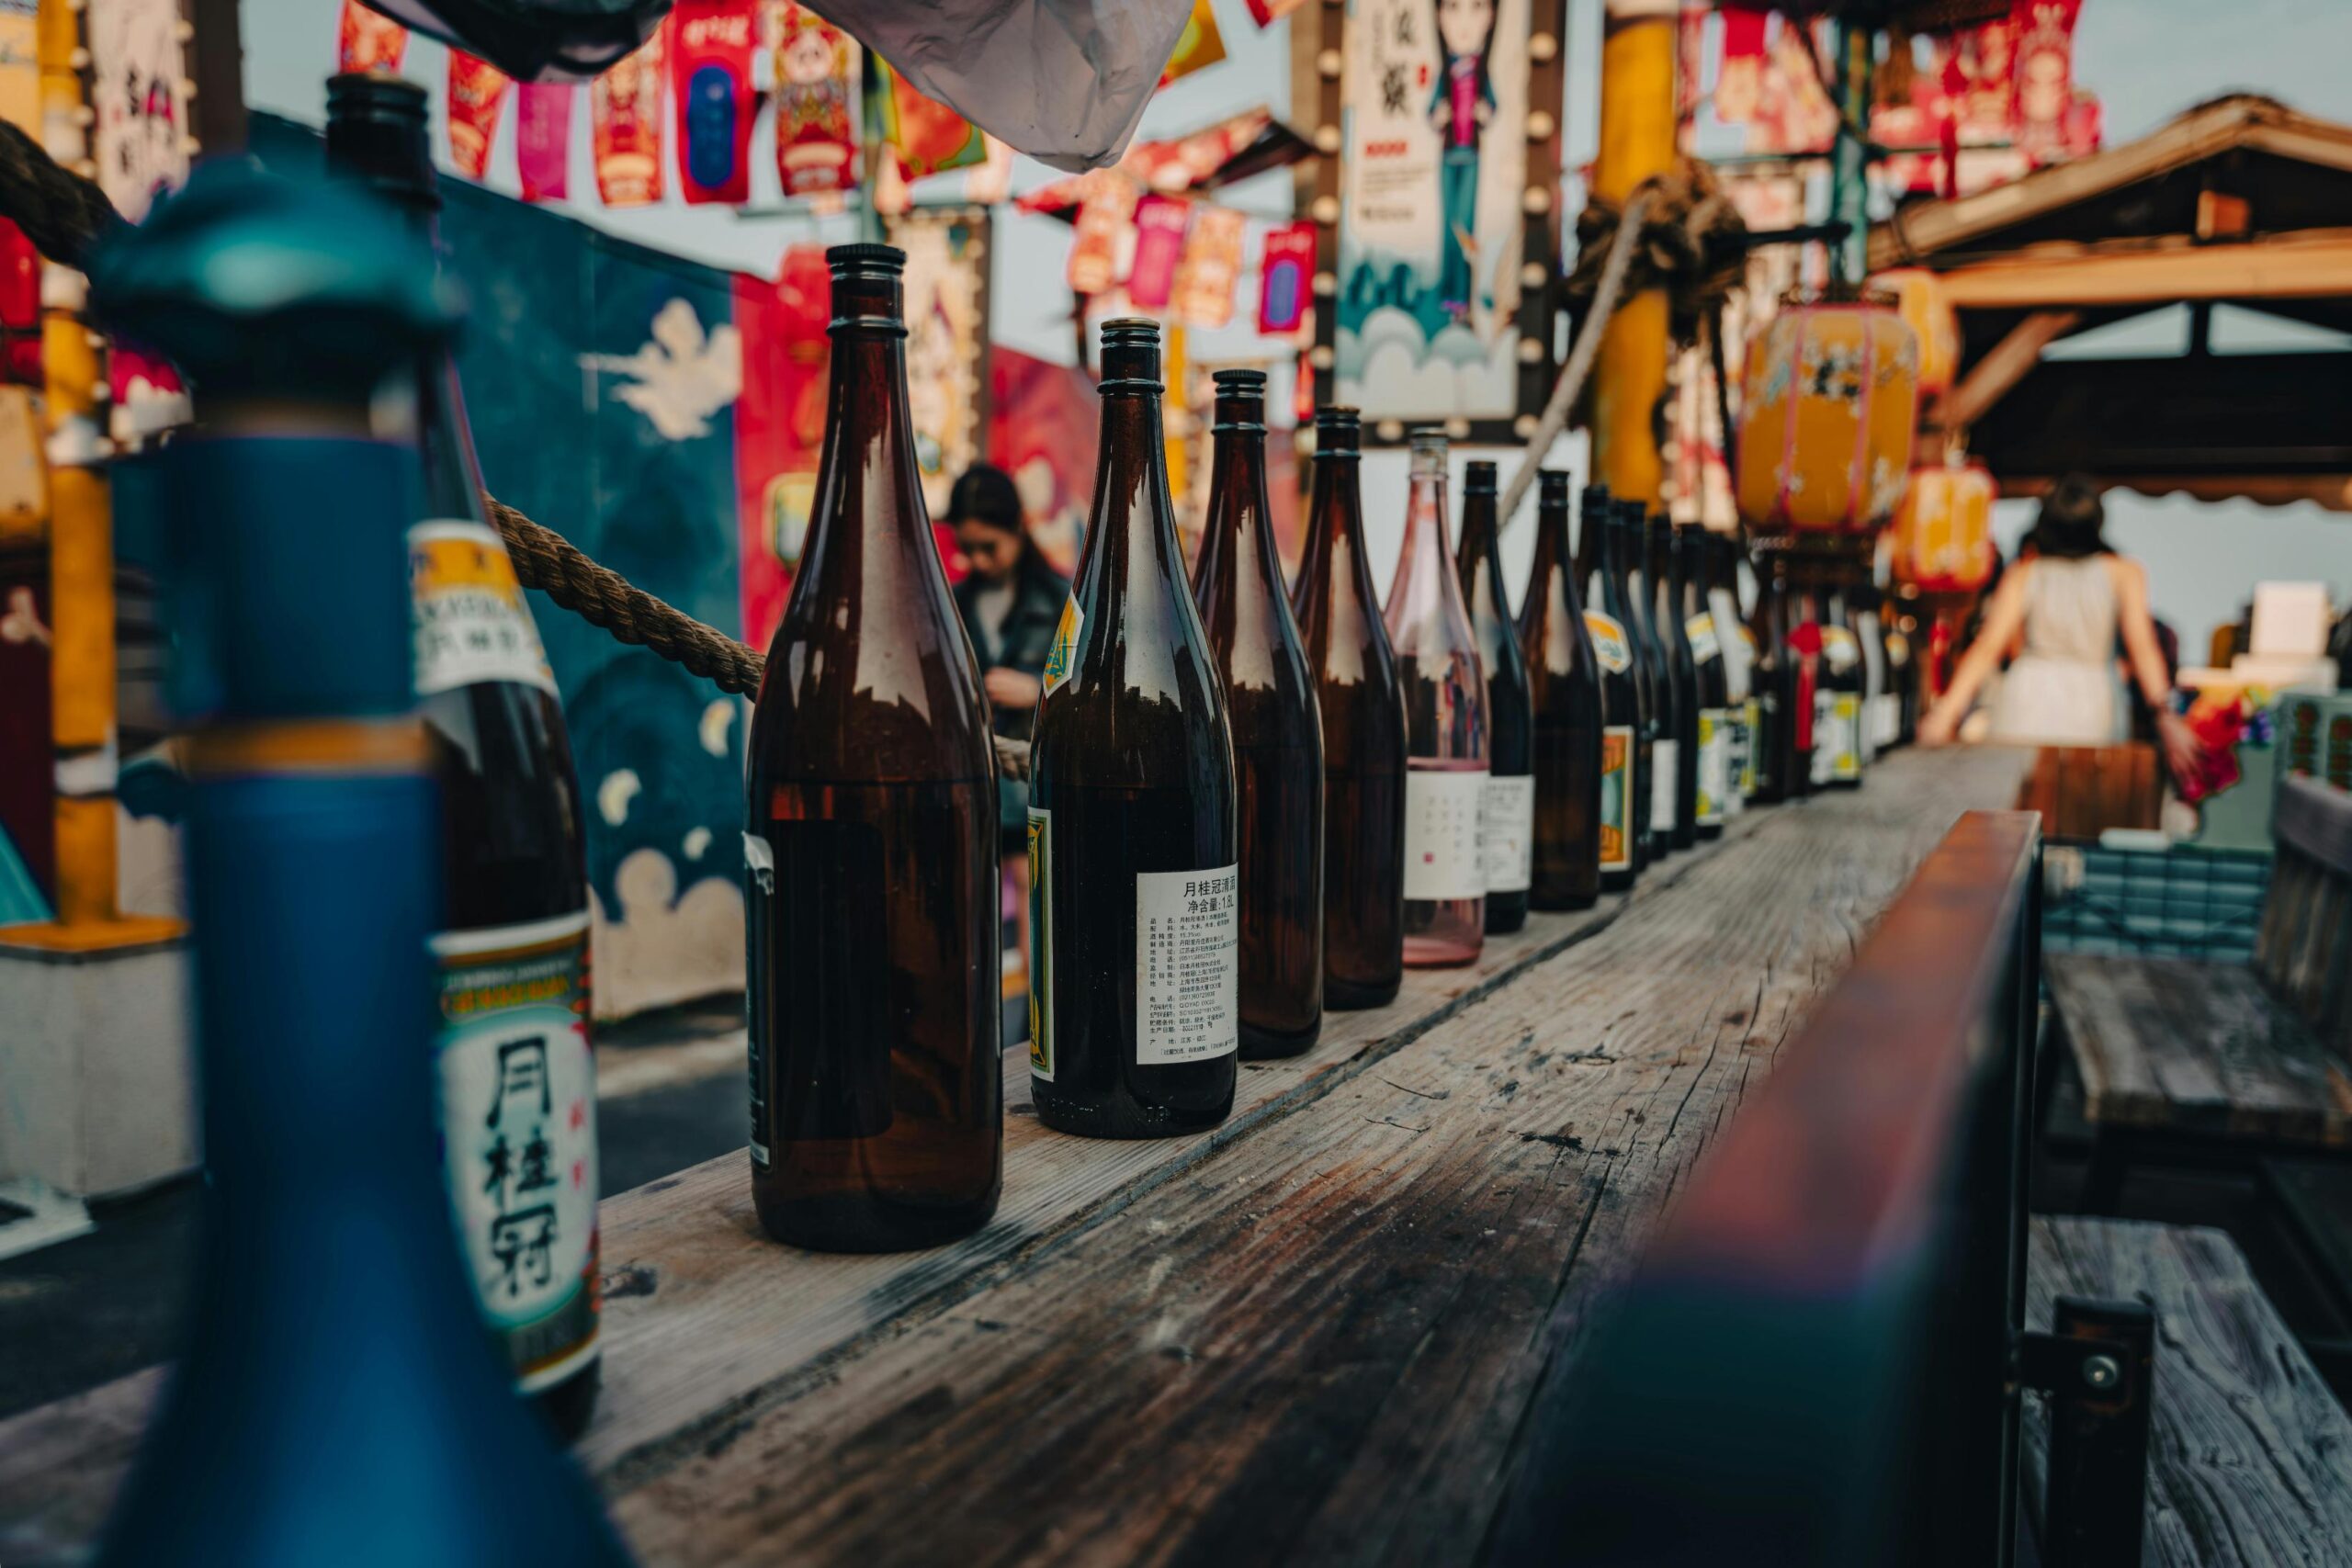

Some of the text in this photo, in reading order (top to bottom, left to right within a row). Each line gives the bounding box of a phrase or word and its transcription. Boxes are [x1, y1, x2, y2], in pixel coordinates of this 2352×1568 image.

[1183, 875, 1236, 897] 月桂冠清酒
[481, 1034, 560, 1297] 月桂冠
